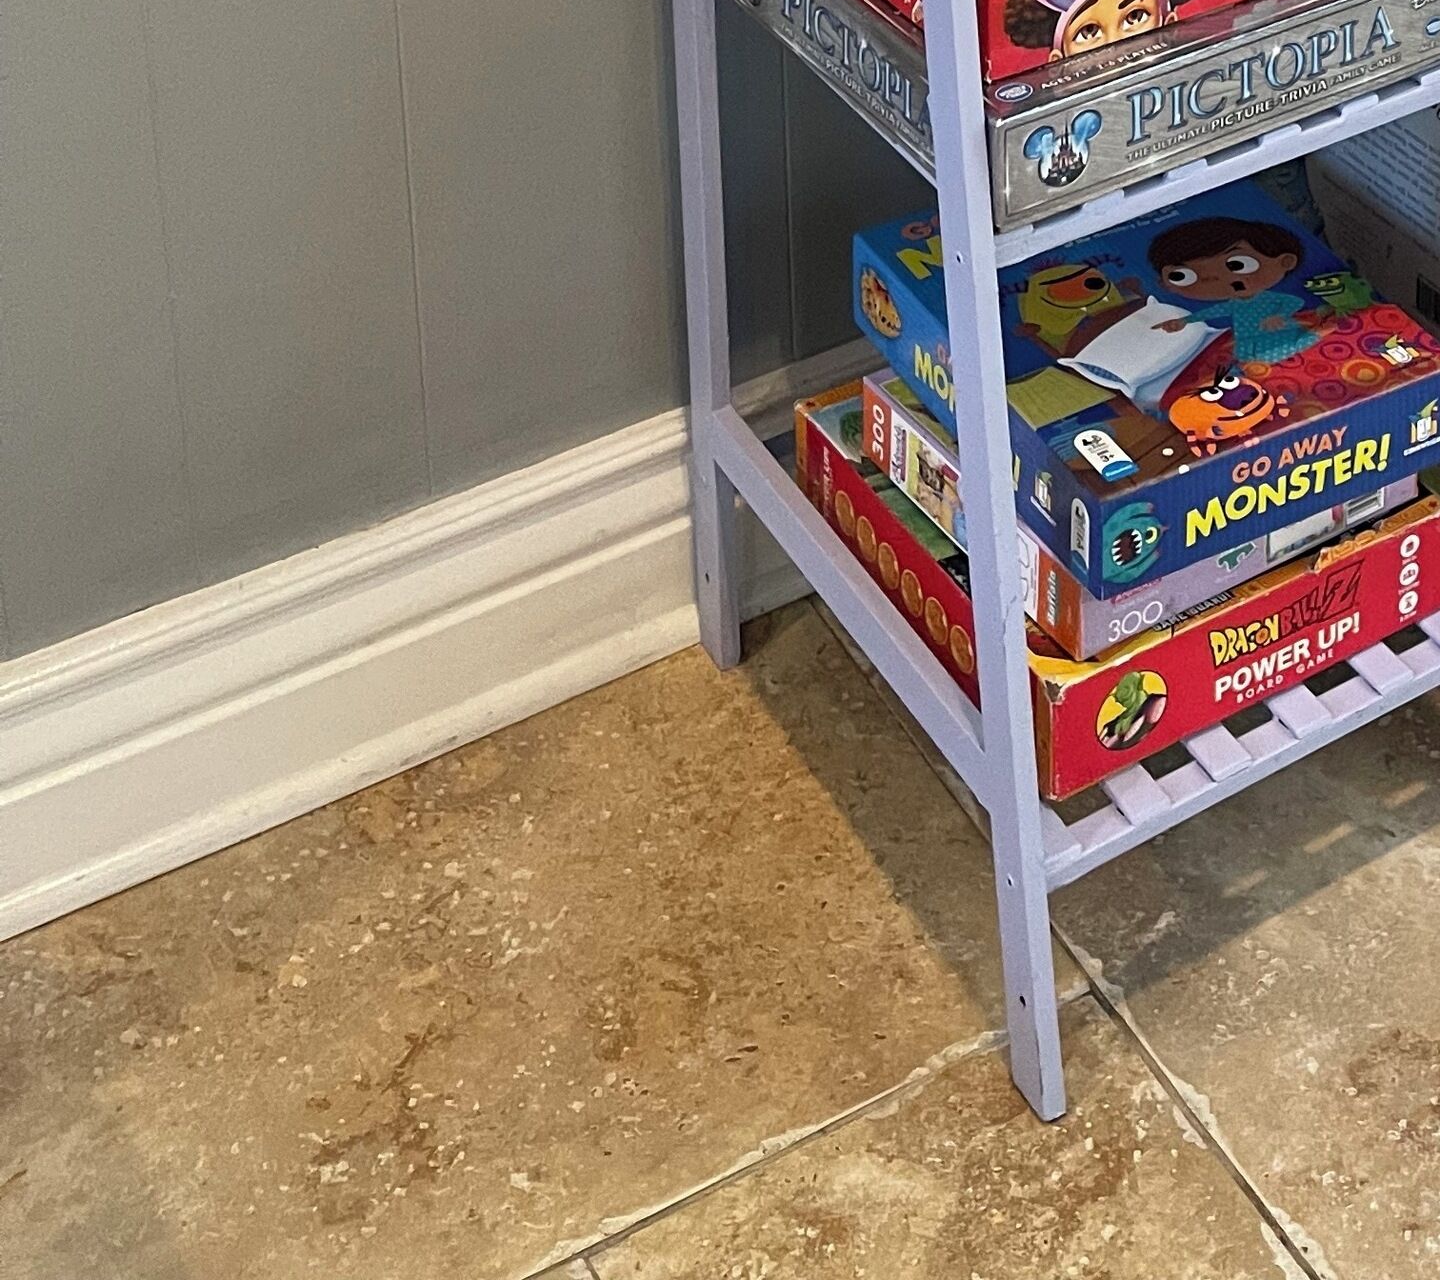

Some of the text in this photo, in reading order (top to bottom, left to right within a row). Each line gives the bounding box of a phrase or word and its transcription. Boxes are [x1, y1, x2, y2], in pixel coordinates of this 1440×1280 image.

[1040, 42, 1169, 90] AGES PLAYERS
[1126, 6, 1400, 146] PICTOPIA
[1126, 54, 1400, 162] THE PICTURE TRIVIA FAMILY GAME
[870, 403, 886, 461] 300
[1231, 425, 1349, 484] GO AWAY
[1185, 433, 1392, 548] MONSTER!
[1106, 599, 1164, 644] 300
[1208, 612, 1281, 668] DRAGON
[1214, 612, 1361, 702] POWER UP!
[1236, 648, 1335, 704] BOARD GAME
